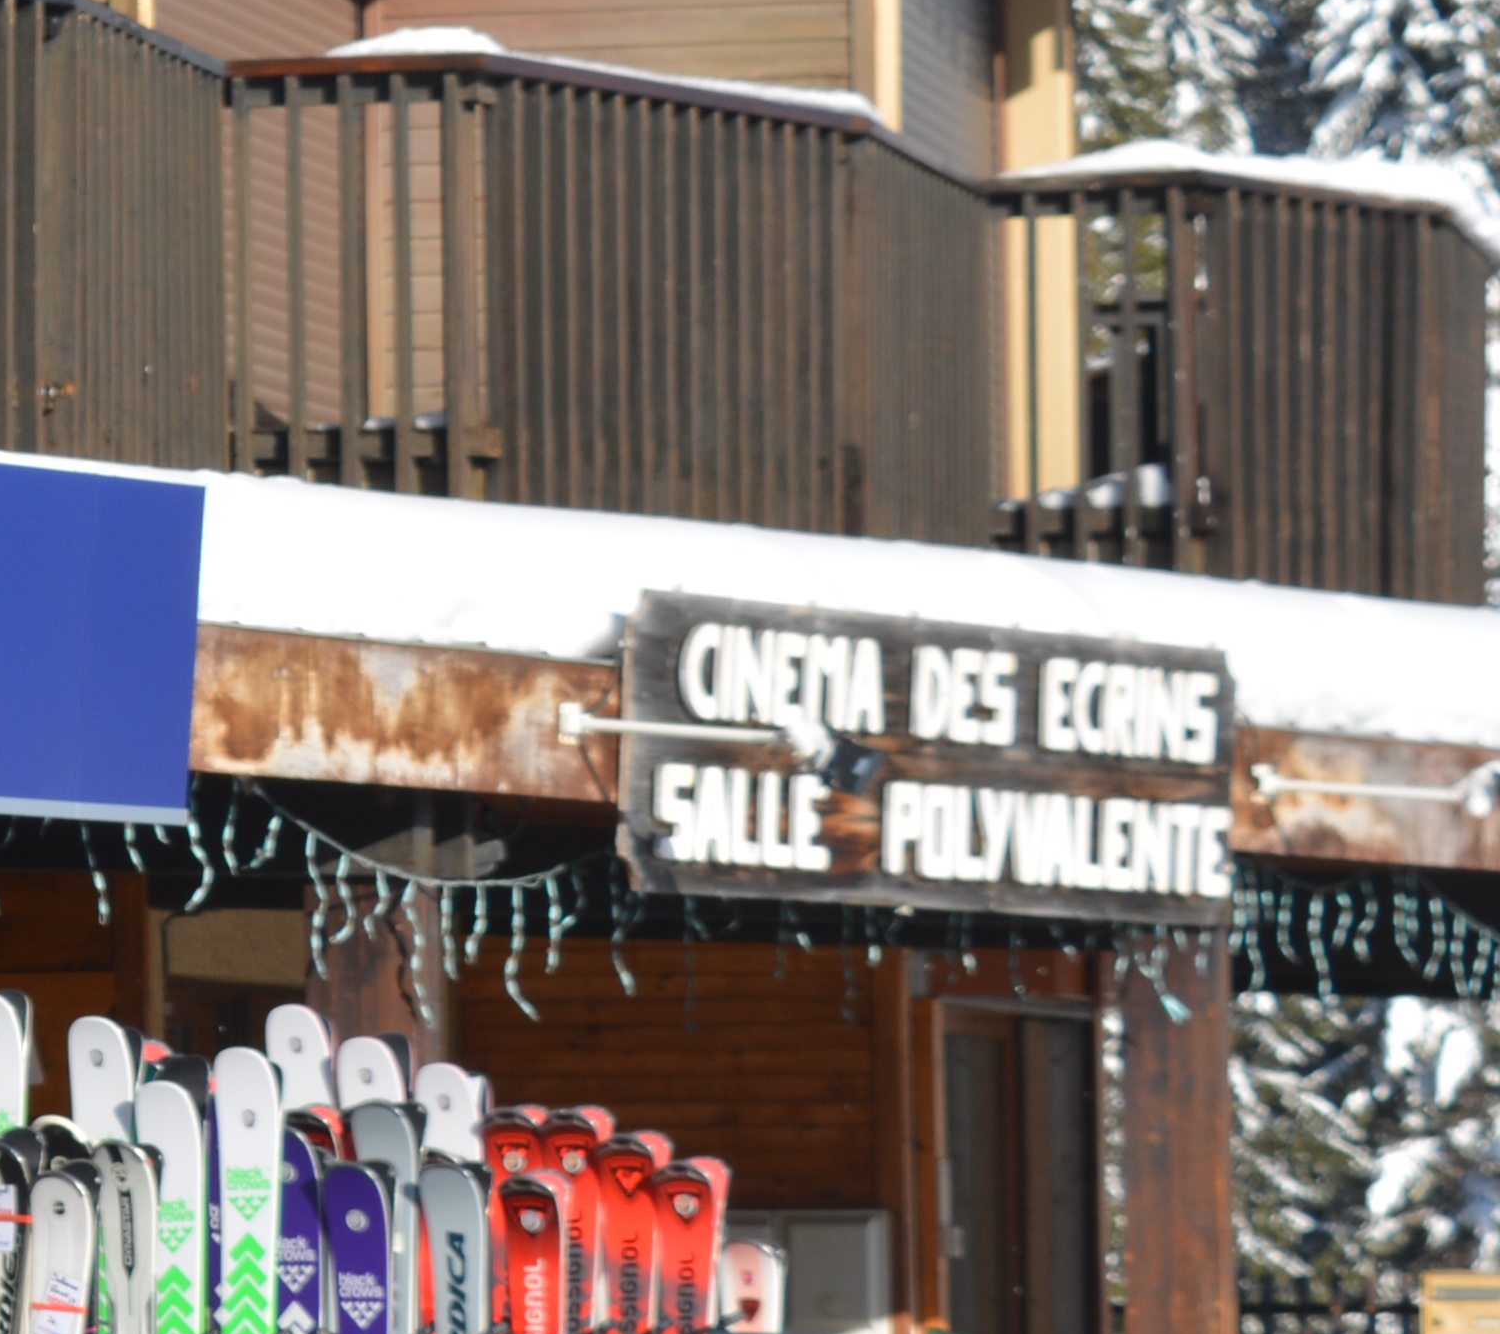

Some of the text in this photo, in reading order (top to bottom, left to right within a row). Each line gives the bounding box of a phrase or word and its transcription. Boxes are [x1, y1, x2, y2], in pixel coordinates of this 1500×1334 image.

[679, 624, 1219, 765] CINEMA DES ECRINS
[655, 764, 1231, 897] SALLE POLYVALENTE
[338, 1271, 379, 1287] black
[338, 1284, 384, 1299] crows
